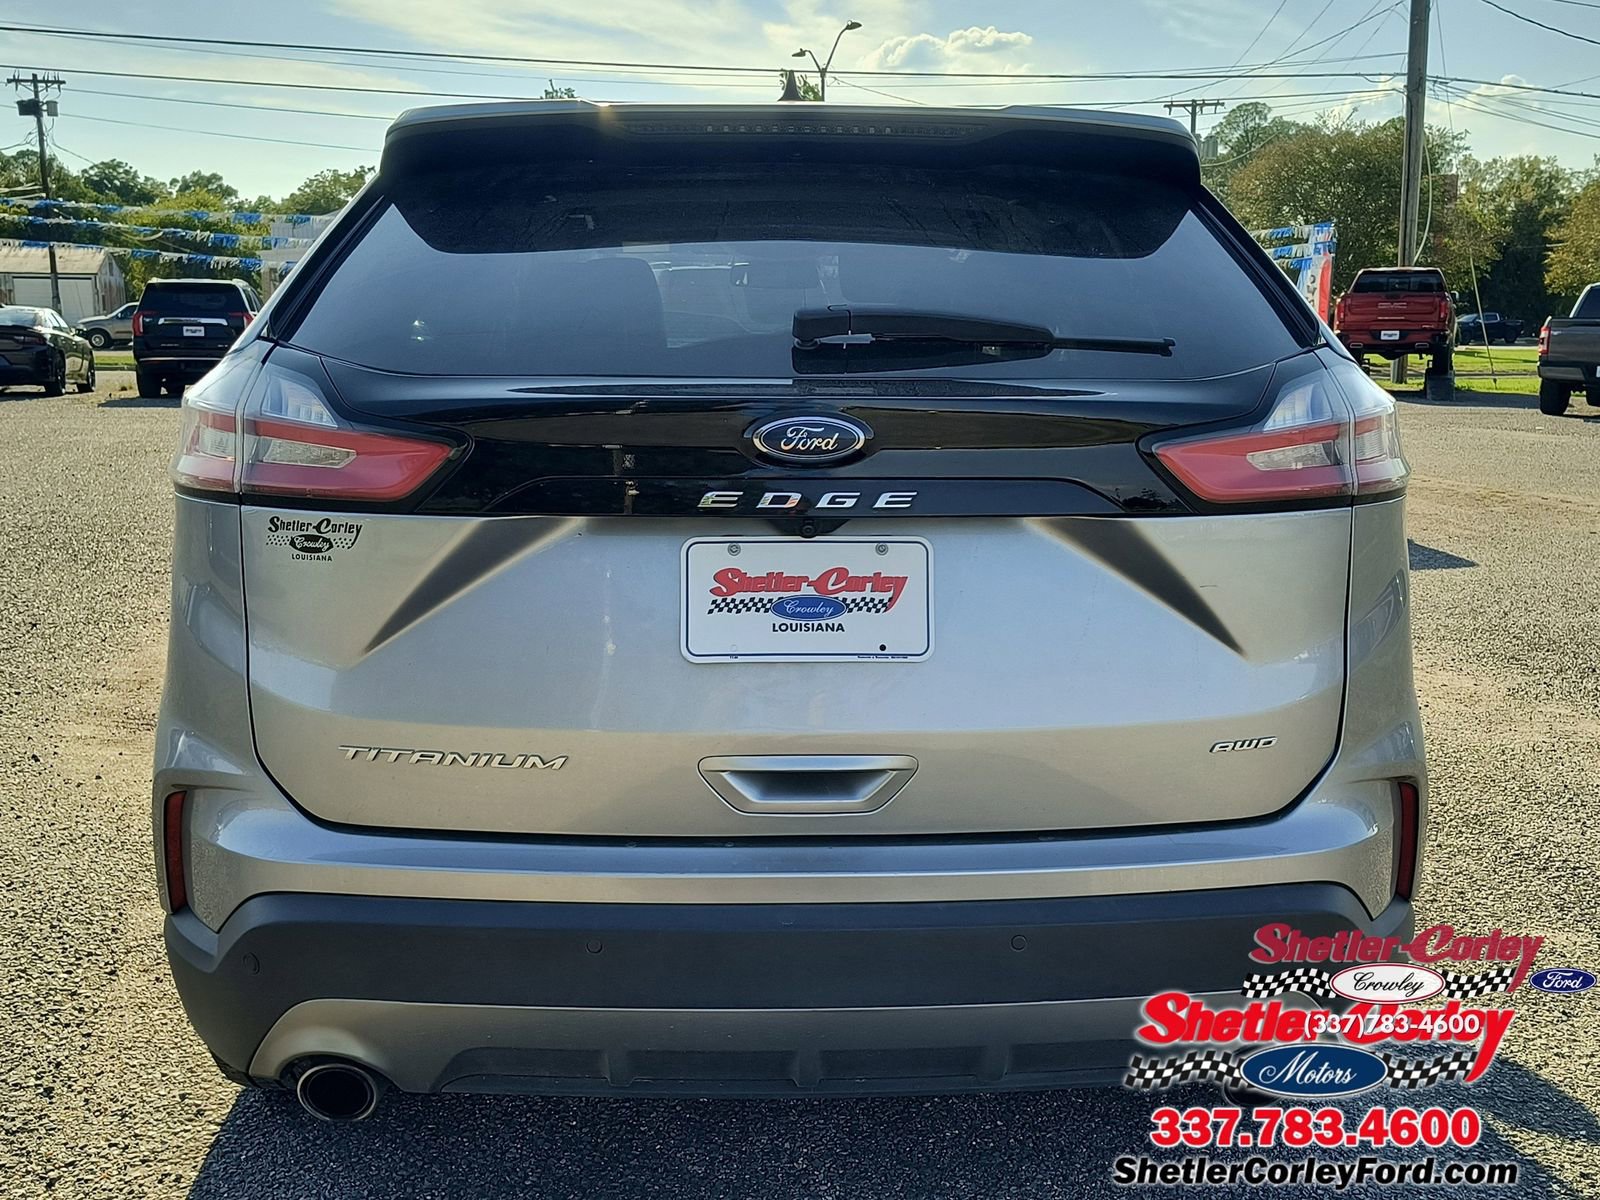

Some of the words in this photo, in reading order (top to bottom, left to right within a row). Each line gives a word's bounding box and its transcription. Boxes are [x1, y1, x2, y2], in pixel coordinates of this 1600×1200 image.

[780, 426, 840, 451] Ford
[697, 491, 918, 509] EDGE
[267, 515, 363, 550] Shetler-Corley
[293, 536, 331, 552] Crowley
[291, 553, 333, 562] LOUISIANA
[709, 566, 909, 613] Shetler-Corley
[783, 601, 835, 618] Crowley
[772, 622, 846, 633] LOUISIANA
[1208, 735, 1278, 753] AWD
[338, 744, 569, 771] TITANIUM
